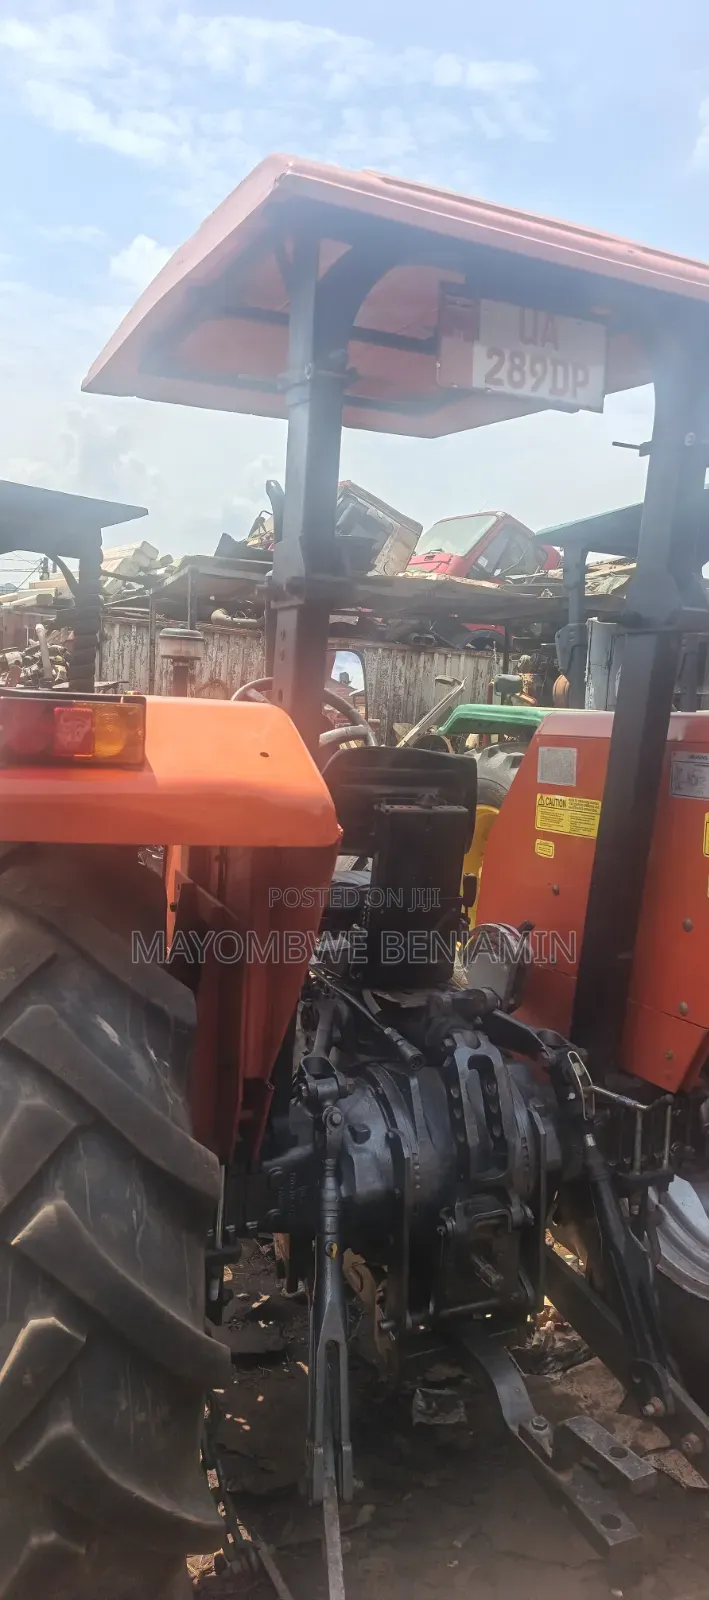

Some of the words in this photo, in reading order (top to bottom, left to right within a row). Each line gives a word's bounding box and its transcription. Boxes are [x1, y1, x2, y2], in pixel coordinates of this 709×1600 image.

[519, 307, 559, 350] UA
[484, 346, 590, 398] 289DP
[545, 796, 567, 808] CAUTION
